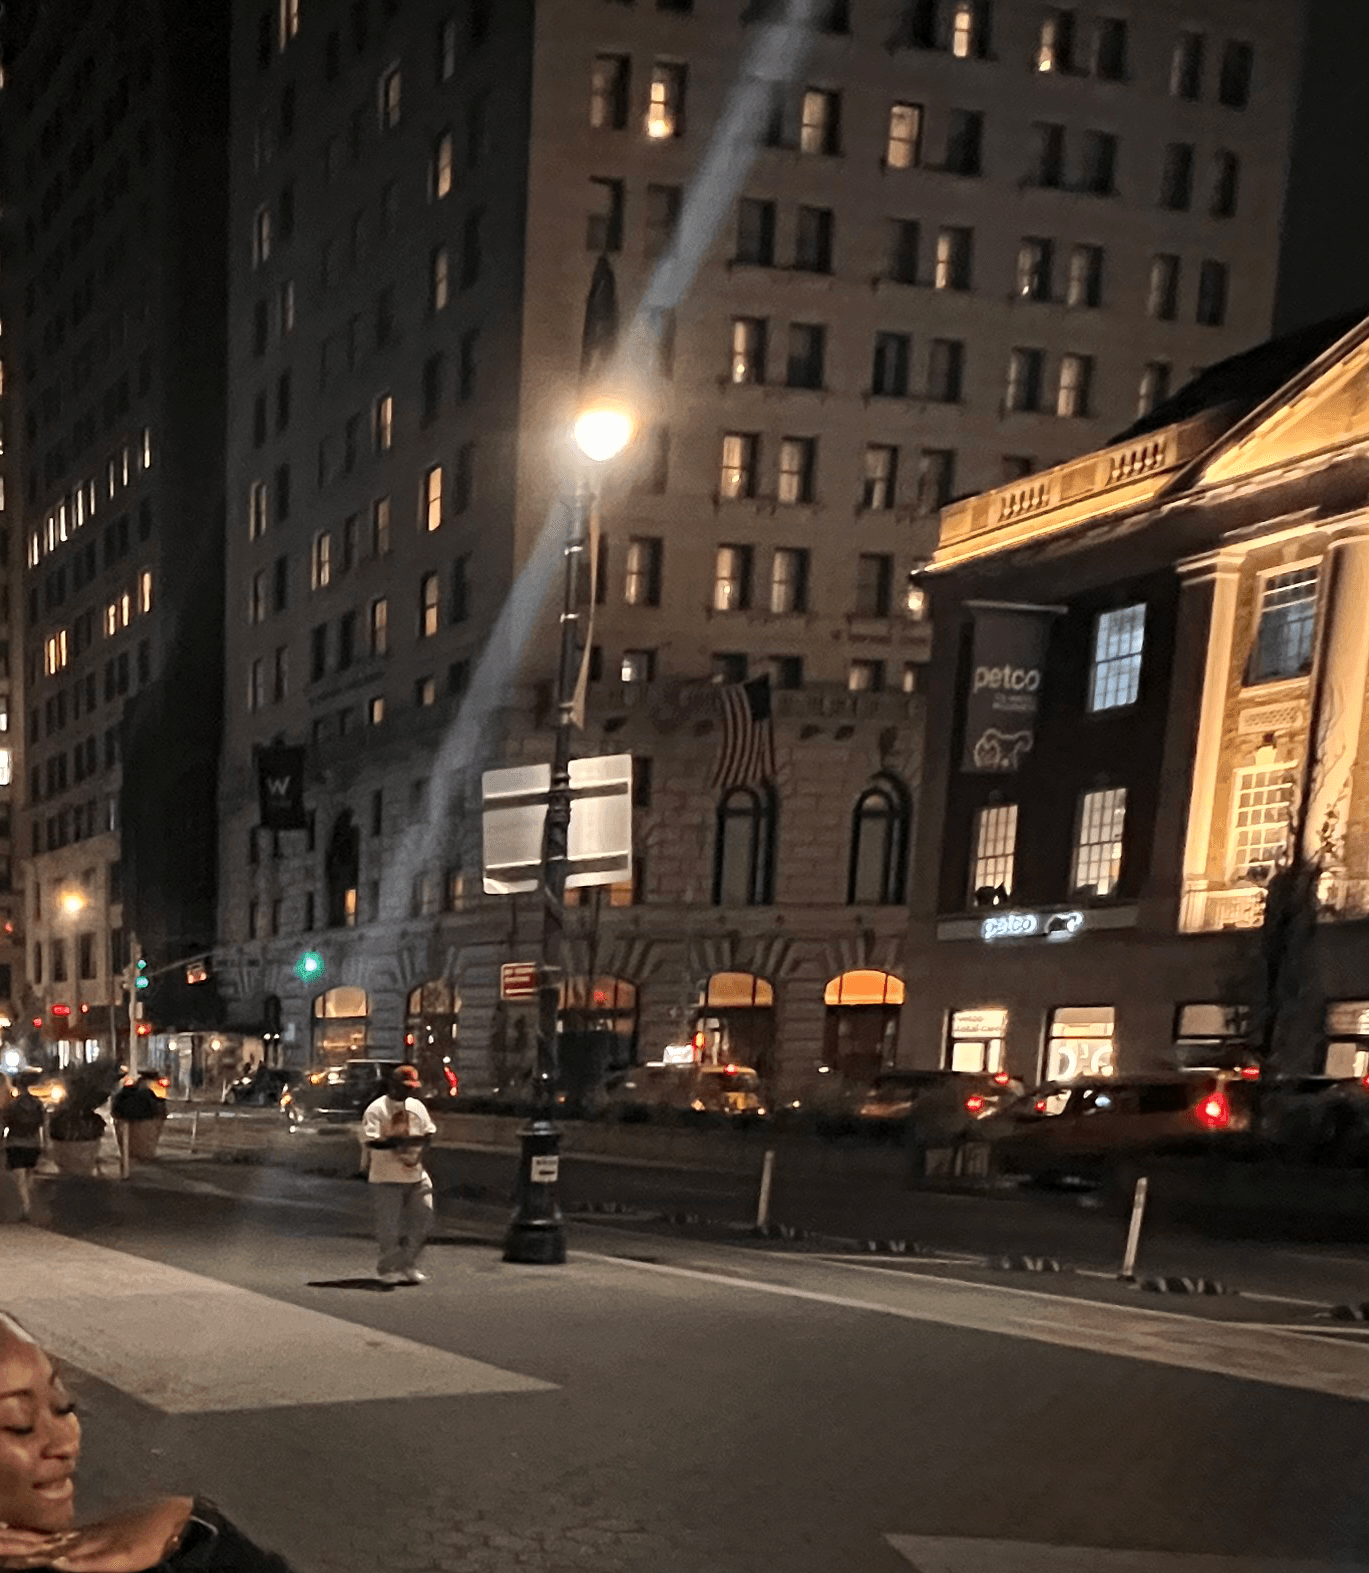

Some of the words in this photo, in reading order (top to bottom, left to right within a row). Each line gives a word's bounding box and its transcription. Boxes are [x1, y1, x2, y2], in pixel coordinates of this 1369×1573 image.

[973, 664, 1041, 694] petco
[265, 775, 292, 796] W
[983, 914, 1037, 940] petco
